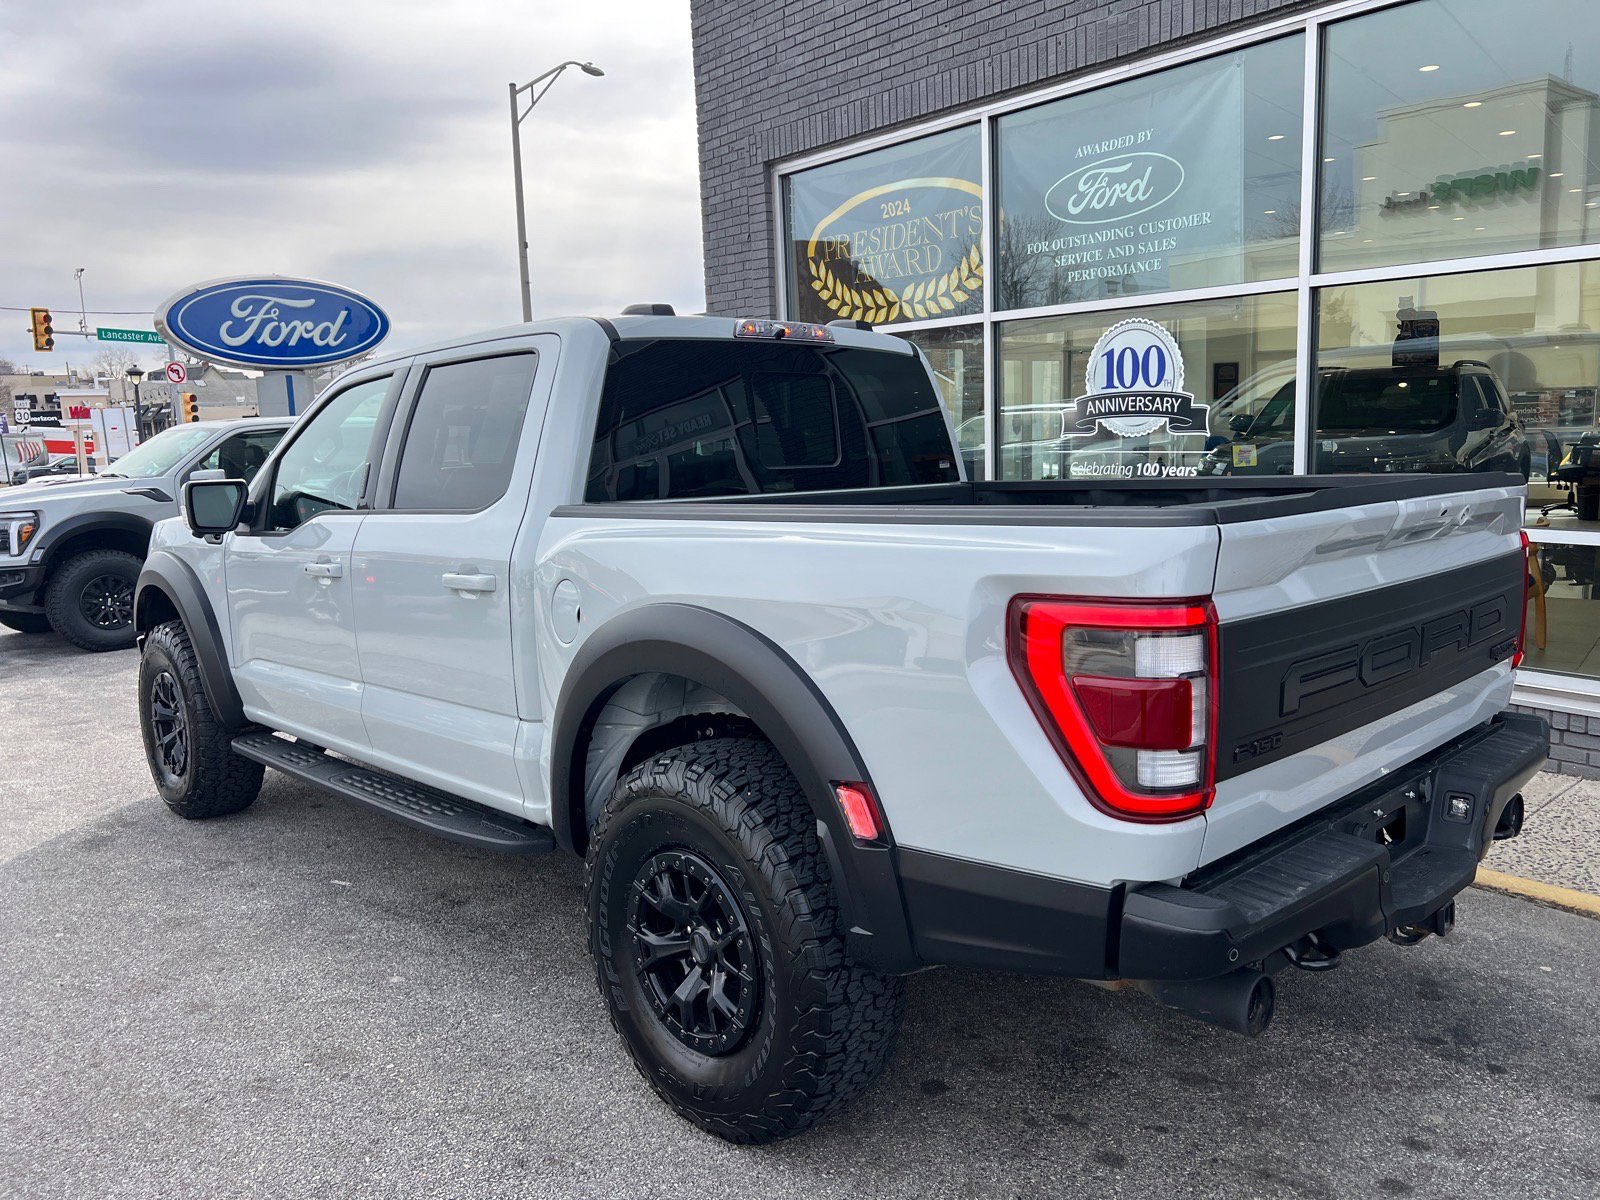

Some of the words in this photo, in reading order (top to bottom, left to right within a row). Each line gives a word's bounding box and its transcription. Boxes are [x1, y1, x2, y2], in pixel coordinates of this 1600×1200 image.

[1074, 134, 1134, 158] AWARDED
[1137, 128, 1154, 144] BY
[1067, 162, 1154, 215] Ford
[880, 198, 911, 219] 2024
[823, 205, 982, 262] PRESIDENT'S
[1027, 241, 1049, 255] FOR
[1052, 226, 1134, 251] OUTSTANDING
[1138, 212, 1212, 236] CUSTOMER
[854, 244, 942, 284] AWARD
[1054, 250, 1103, 268] SERVICE
[1107, 244, 1134, 260] AND
[1138, 237, 1177, 256] SALES
[1067, 258, 1162, 283] PERFORMANCE
[102, 330, 144, 341] Lancaster
[219, 294, 348, 347] Ford
[1101, 344, 1166, 390] 100
[1163, 379, 1172, 388] TH
[17, 412, 30, 421] 30
[1086, 396, 1182, 415] ANNIVERSARY
[1070, 461, 1133, 478] Celebrating
[1136, 462, 1159, 476] 100
[1161, 464, 1198, 478] years
[1279, 594, 1509, 718] FORD
